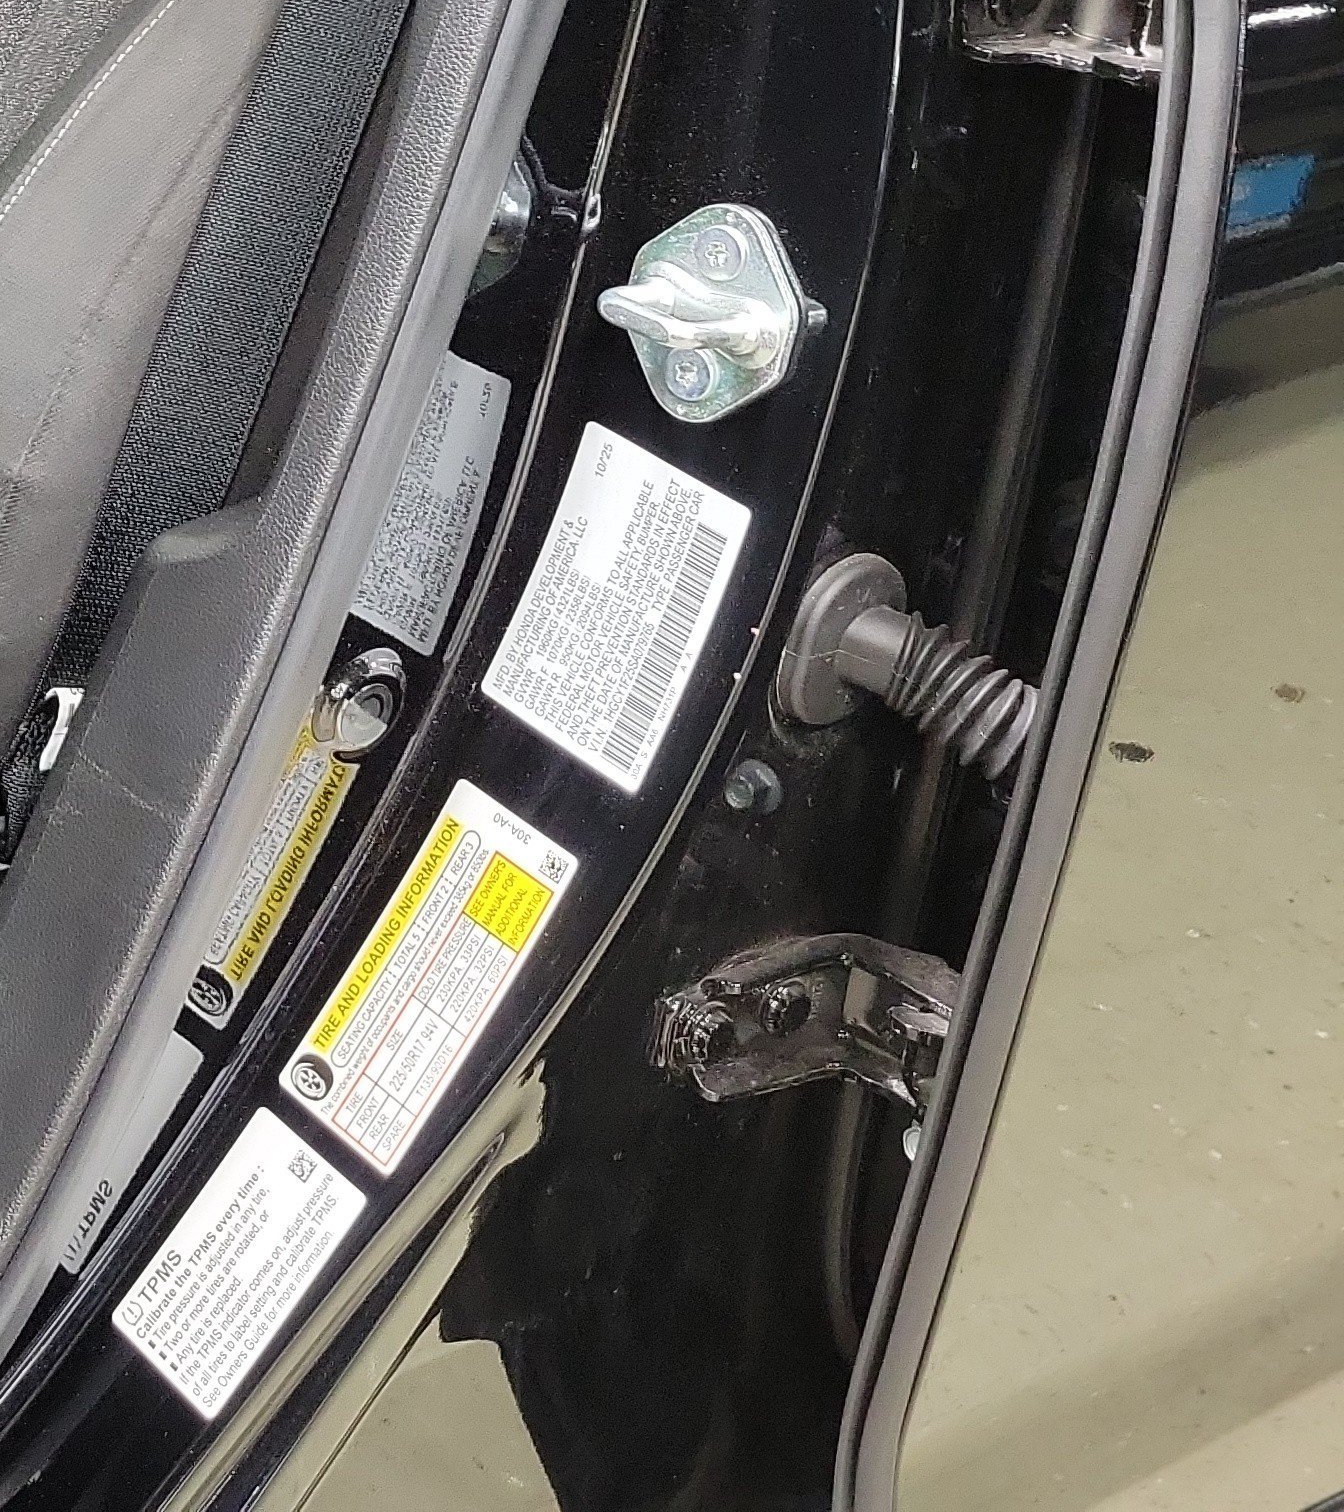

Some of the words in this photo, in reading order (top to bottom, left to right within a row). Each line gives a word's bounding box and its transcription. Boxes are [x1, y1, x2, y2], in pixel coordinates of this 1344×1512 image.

[593, 441, 613, 478] 10/25
[621, 478, 655, 550] APPLICABLE
[651, 522, 666, 539] IN
[656, 476, 681, 525] EFFECT
[529, 525, 571, 609] DEVELOPMENT
[605, 568, 621, 585] TO
[613, 549, 630, 571] ALL
[625, 536, 660, 607] STANDARDS
[649, 582, 670, 612] TYPE
[661, 514, 696, 583] PASSENGER
[687, 489, 705, 516] CAR
[652, 526, 678, 573] SHOWN
[501, 601, 551, 699] MANUFACTURING
[544, 586, 558, 606] OF
[571, 515, 588, 539] LLC
[511, 607, 538, 647] HONDA
[578, 585, 614, 650] CONFORMS
[593, 604, 633, 679] PREVENTION
[617, 570, 661, 658] MANUFACTURE
[491, 663, 512, 690] MFD.
[504, 643, 519, 663] BY
[512, 666, 537, 703] GVWR
[534, 617, 559, 657] 1960KG
[523, 674, 547, 710] GAWR
[539, 664, 549, 676] F
[545, 624, 570, 664] 1070KG
[533, 681, 558, 717] GAWR
[549, 671, 562, 684] R
[557, 631, 580, 667] 950KG
[553, 682, 586, 733] FEDERAL
[578, 638, 605, 682] MOTOR
[596, 590, 626, 638] VEHICLE
[555, 649, 586, 697] VEHICLE
[595, 672, 618, 706] DATE
[610, 654, 624, 674] OF
[542, 696, 563, 724] THIS
[565, 713, 584, 741] AND
[576, 675, 601, 714] THEFT
[583, 702, 604, 728] THE
[575, 726, 592, 747] ON
[312, 1013, 341, 1048] TIRE
[336, 982, 360, 1017] AND
[354, 916, 401, 984] LOADING
[394, 816, 460, 919] INFORMATION
[336, 1019, 366, 1060] SEATING
[360, 975, 392, 1022] CAPACITY
[392, 940, 417, 970] TOTAL
[410, 931, 421, 942] 5
[420, 890, 445, 925] FRONT
[439, 884, 449, 895] 2
[449, 847, 470, 876] REAR
[464, 840, 474, 851] 3
[344, 1090, 364, 1114] TIRE
[385, 1027, 404, 1051] SIZE
[416, 975, 436, 1001] COLD
[429, 957, 448, 978] TIRE
[440, 916, 472, 961] PRESSURE
[468, 897, 485, 918] SEE
[354, 1094, 380, 1130] FRONT
[459, 933, 481, 964] 33PSI
[480, 891, 508, 928] MANUAL
[500, 871, 518, 893] FOR
[367, 1112, 390, 1140] REAR
[472, 944, 495, 974] 32PSI
[493, 887, 528, 937] ADDITIONAL
[380, 1118, 407, 1152] SPARE
[486, 953, 508, 984] 60PSI
[506, 886, 546, 946] INFORMATION
[387, 1037, 426, 1093] 225/50R17
[419, 1016, 439, 1042] 94V
[135, 1287, 177, 1339] Calibrate
[173, 1266, 192, 1288] the
[186, 1230, 217, 1266] TPMS
[214, 1197, 241, 1233] every
[236, 1172, 259, 1200] time
[136, 1248, 182, 1303] TPMS
[150, 1320, 172, 1341] Tire
[167, 1280, 201, 1325] pressure
[194, 1270, 208, 1283] is
[203, 1229, 236, 1273] adjusted
[232, 1221, 244, 1234] in
[239, 1202, 257, 1224] any
[162, 1329, 184, 1352] Two
[180, 1317, 192, 1332] or
[188, 1294, 210, 1321] more
[204, 1272, 225, 1296] tires
[221, 1256, 237, 1276] are
[258, 1208, 270, 1223] or
[177, 1371, 190, 1385] If
[184, 1358, 201, 1377] the
[195, 1327, 223, 1360] TPMS
[216, 1288, 251, 1332] indicator
[247, 1258, 274, 1292] comes
[281, 1211, 307, 1245] adjust
[301, 1172, 334, 1217] pressure
[174, 1341, 195, 1365] Any
[188, 1326, 206, 1345] tire
[199, 1316, 213, 1329] is
[191, 1379, 203, 1397] of
[199, 1368, 213, 1386] all
[206, 1349, 228, 1374] tires
[221, 1339, 236, 1353] to
[229, 1313, 253, 1342] label
[248, 1284, 277, 1319] setting
[270, 1263, 289, 1287] and
[284, 1225, 317, 1267] calibrate
[201, 1386, 221, 1408] See
[242, 1320, 269, 1351] Guide
[262, 1305, 278, 1323] for
[275, 1281, 297, 1309] more
